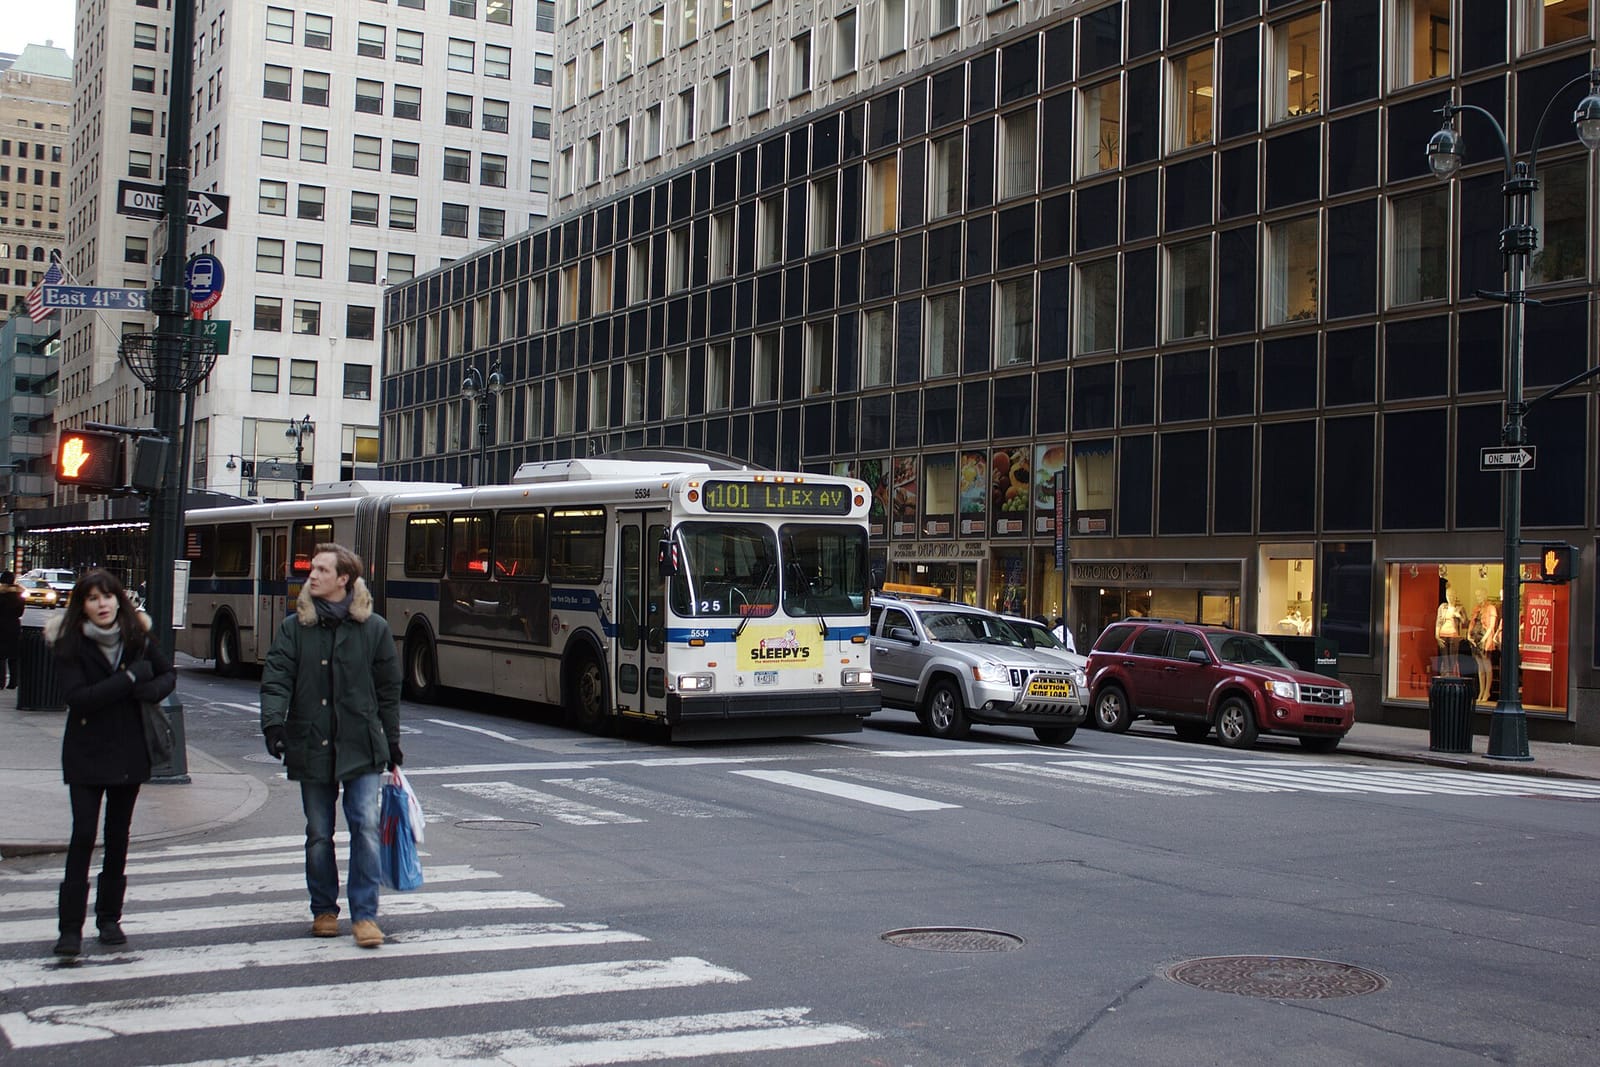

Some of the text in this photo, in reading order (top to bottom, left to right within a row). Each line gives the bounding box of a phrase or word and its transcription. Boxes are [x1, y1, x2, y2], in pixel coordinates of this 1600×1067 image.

[45, 288, 145, 307] East 41ST St
[1488, 454, 1526, 463] ONE WAY
[634, 488, 650, 499] 5534
[706, 484, 750, 508] M101
[820, 491, 842, 506] AV
[1530, 608, 1549, 625] 30%
[690, 629, 709, 637] 5534
[1530, 625, 1548, 642] OFF
[751, 647, 810, 659] SLEEPY'S
